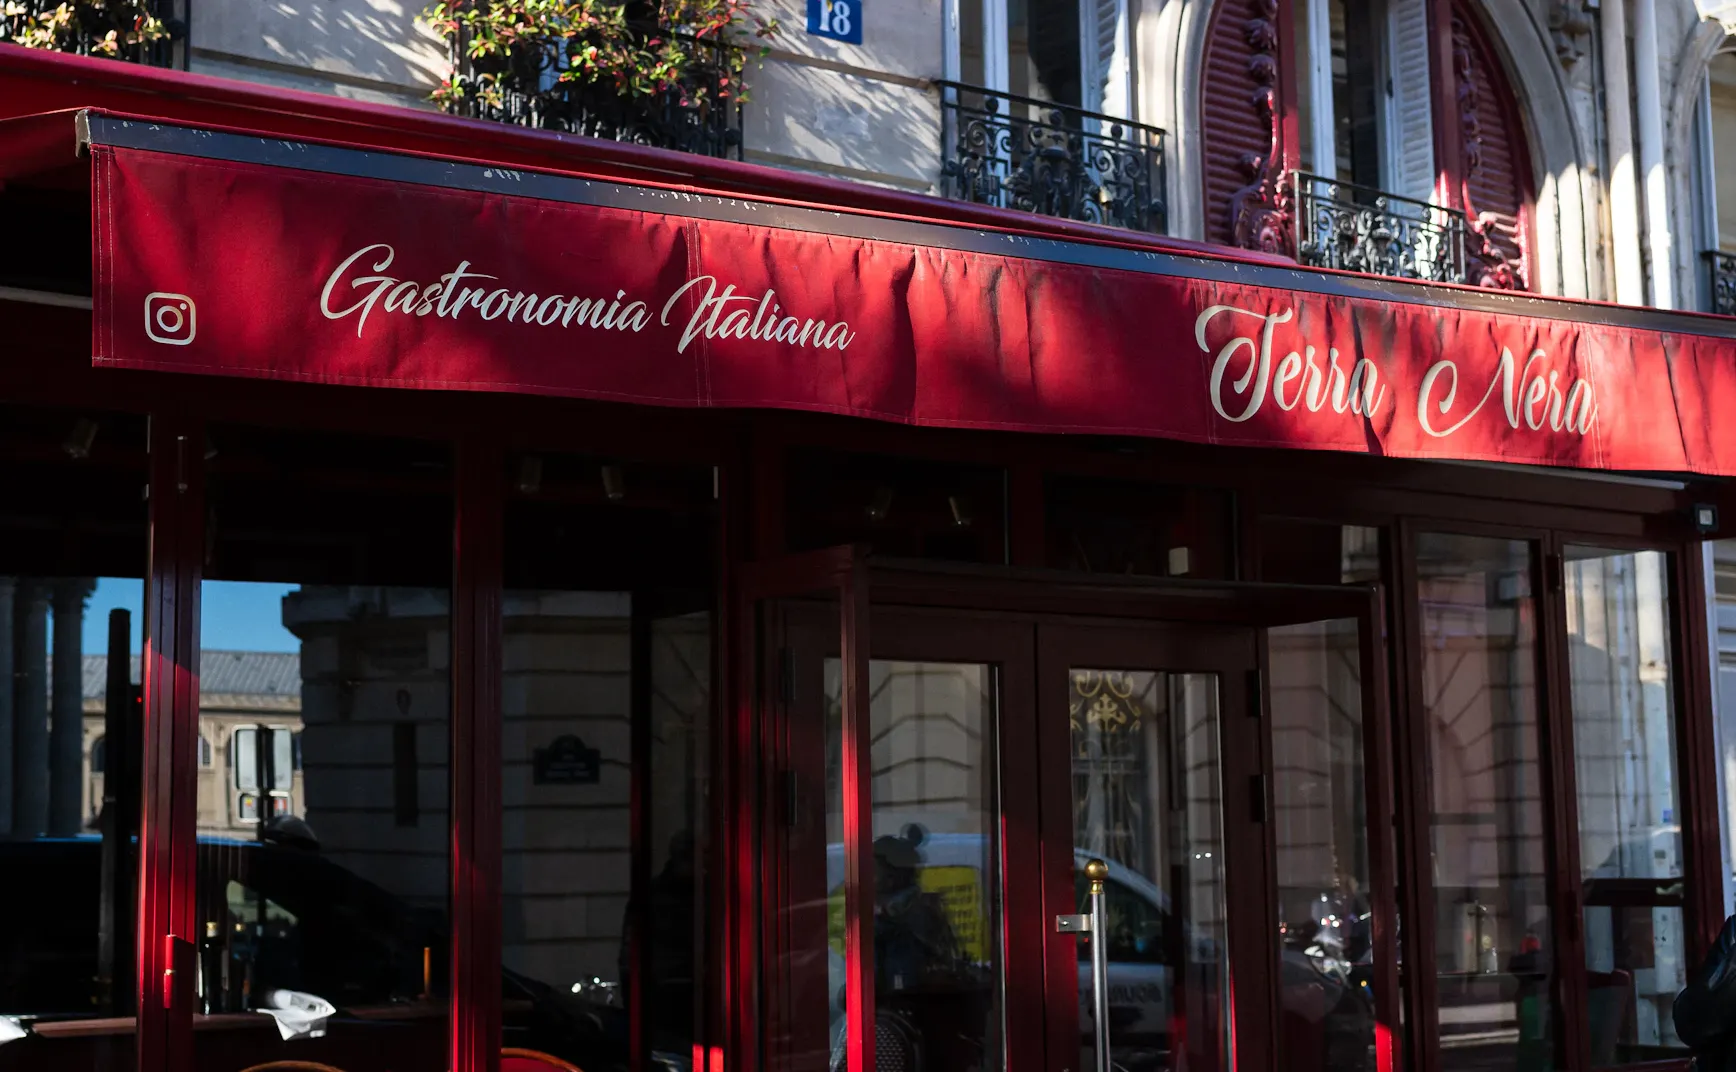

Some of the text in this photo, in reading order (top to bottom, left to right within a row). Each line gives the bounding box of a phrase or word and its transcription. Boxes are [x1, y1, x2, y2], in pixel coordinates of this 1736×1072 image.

[818, 0, 852, 36] 18
[320, 243, 855, 354] Gastronomia Italiana
[1194, 304, 1598, 438] Terra Nera
